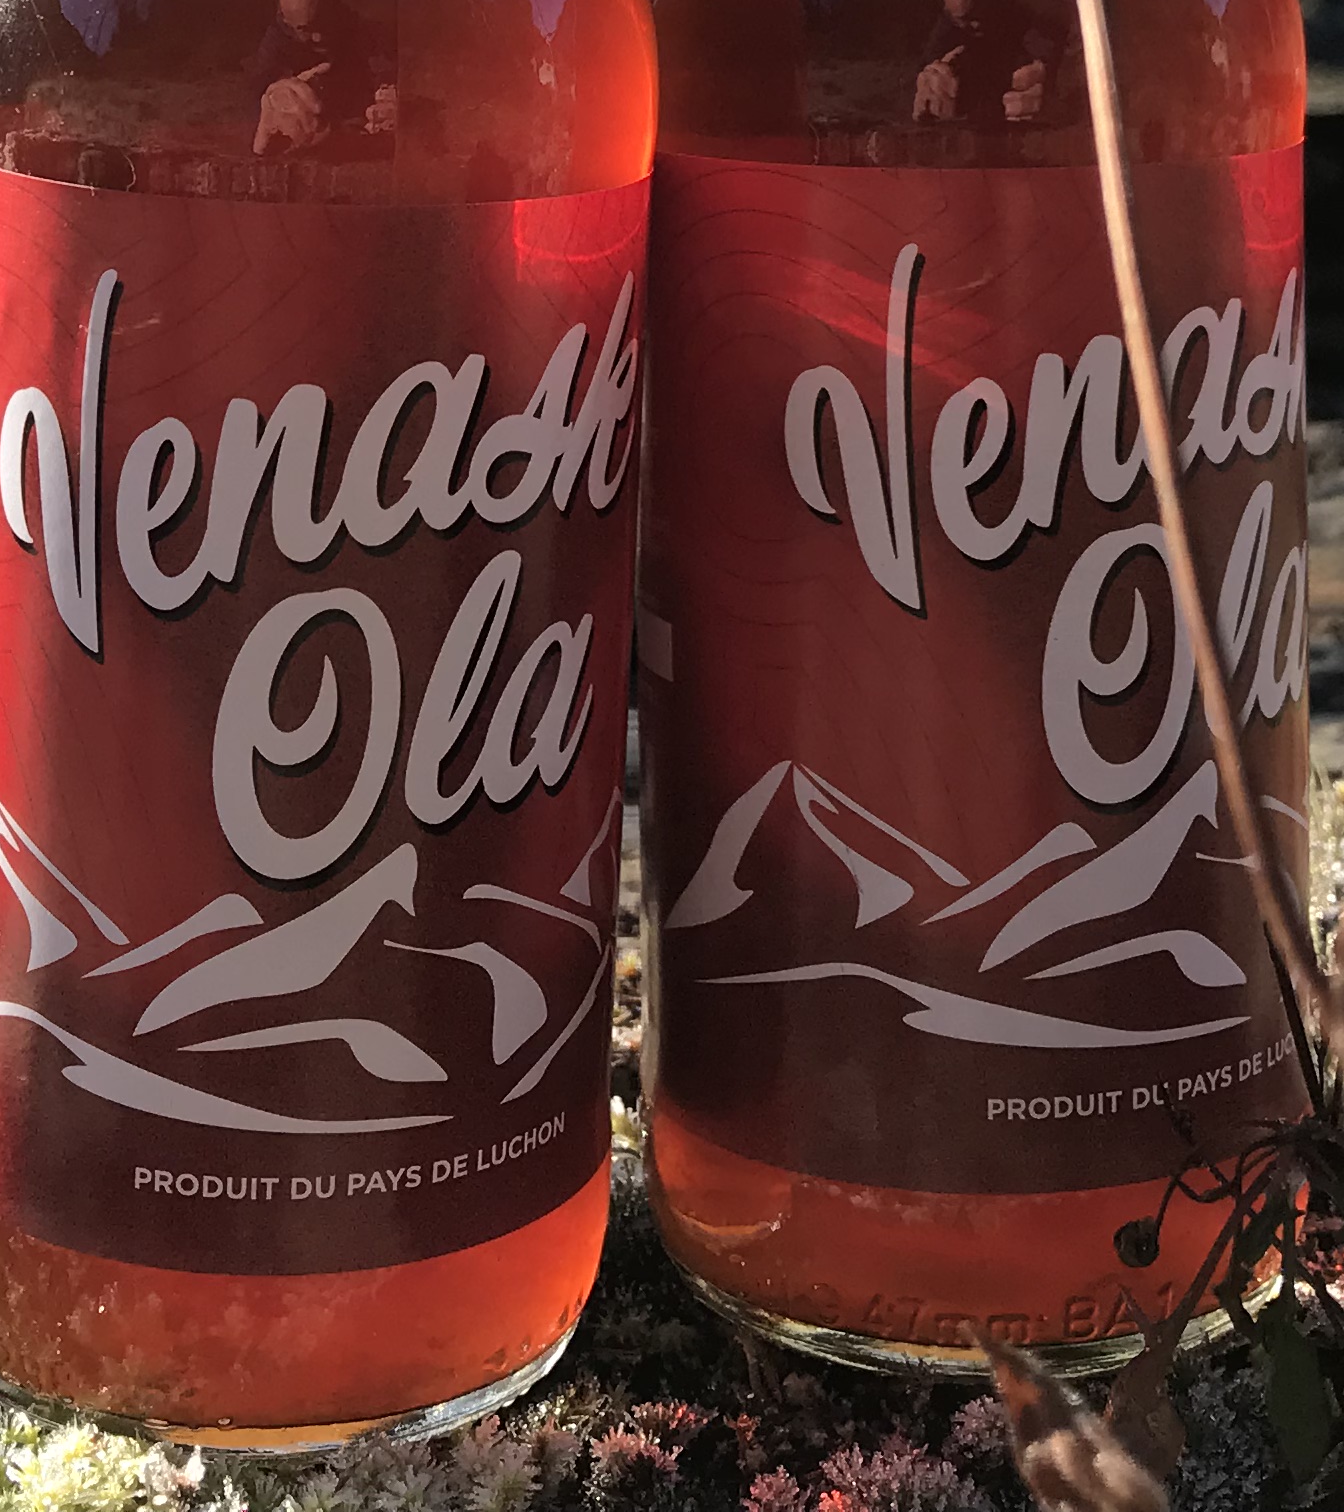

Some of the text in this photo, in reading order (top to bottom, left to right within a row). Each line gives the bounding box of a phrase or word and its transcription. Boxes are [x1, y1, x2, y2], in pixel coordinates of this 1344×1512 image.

[783, 242, 1306, 612] Venas
[211, 549, 594, 882] Ola
[1041, 479, 1306, 806] Ola
[133, 1111, 567, 1202] PRODUIT DU PAYS DE LUCHON
[986, 1090, 1123, 1121] PRODUIT
[1131, 1082, 1171, 1111] DU
[1177, 1065, 1233, 1101] PAYS
[1238, 1051, 1263, 1082] DE
